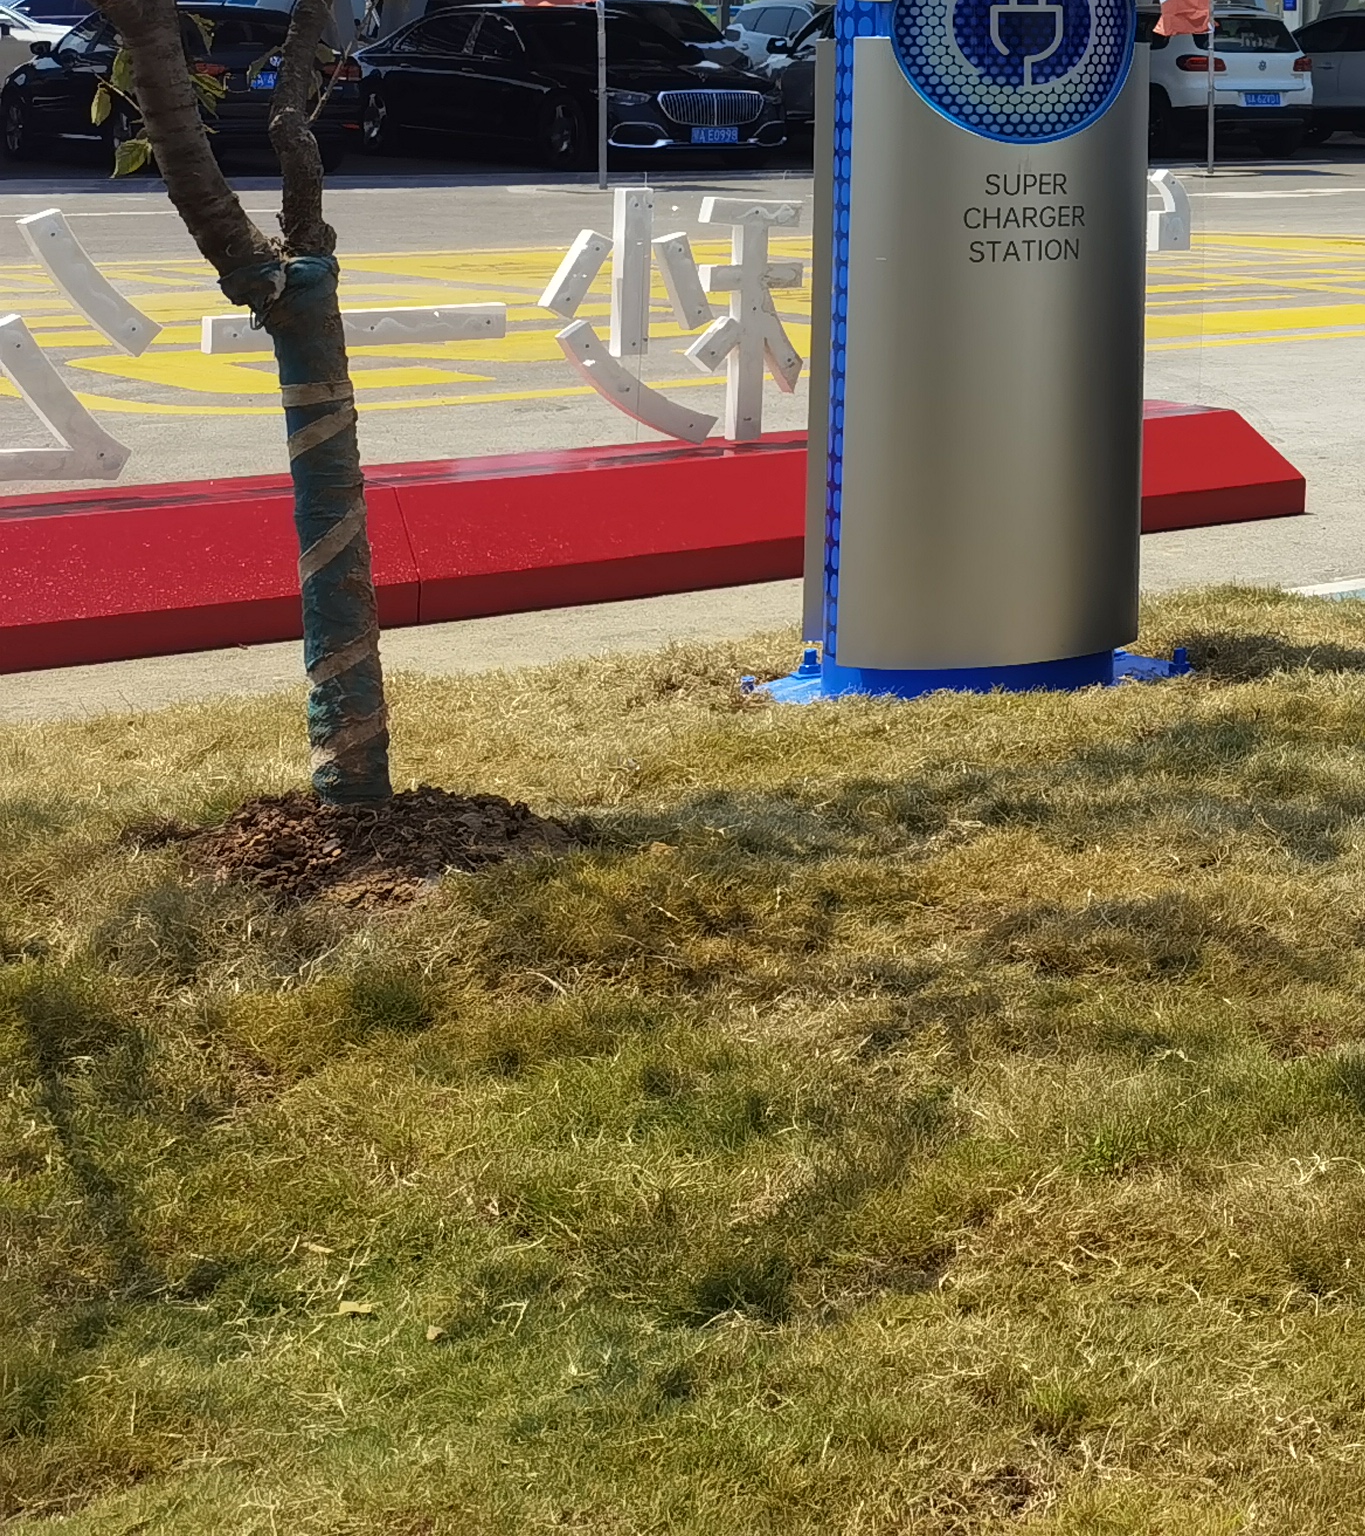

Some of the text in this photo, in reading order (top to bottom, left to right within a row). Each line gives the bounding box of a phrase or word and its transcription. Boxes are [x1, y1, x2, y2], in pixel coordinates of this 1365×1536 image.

[984, 172, 1068, 196] SUPER
[963, 205, 1086, 230] CHARGER
[968, 238, 1080, 263] STATION
